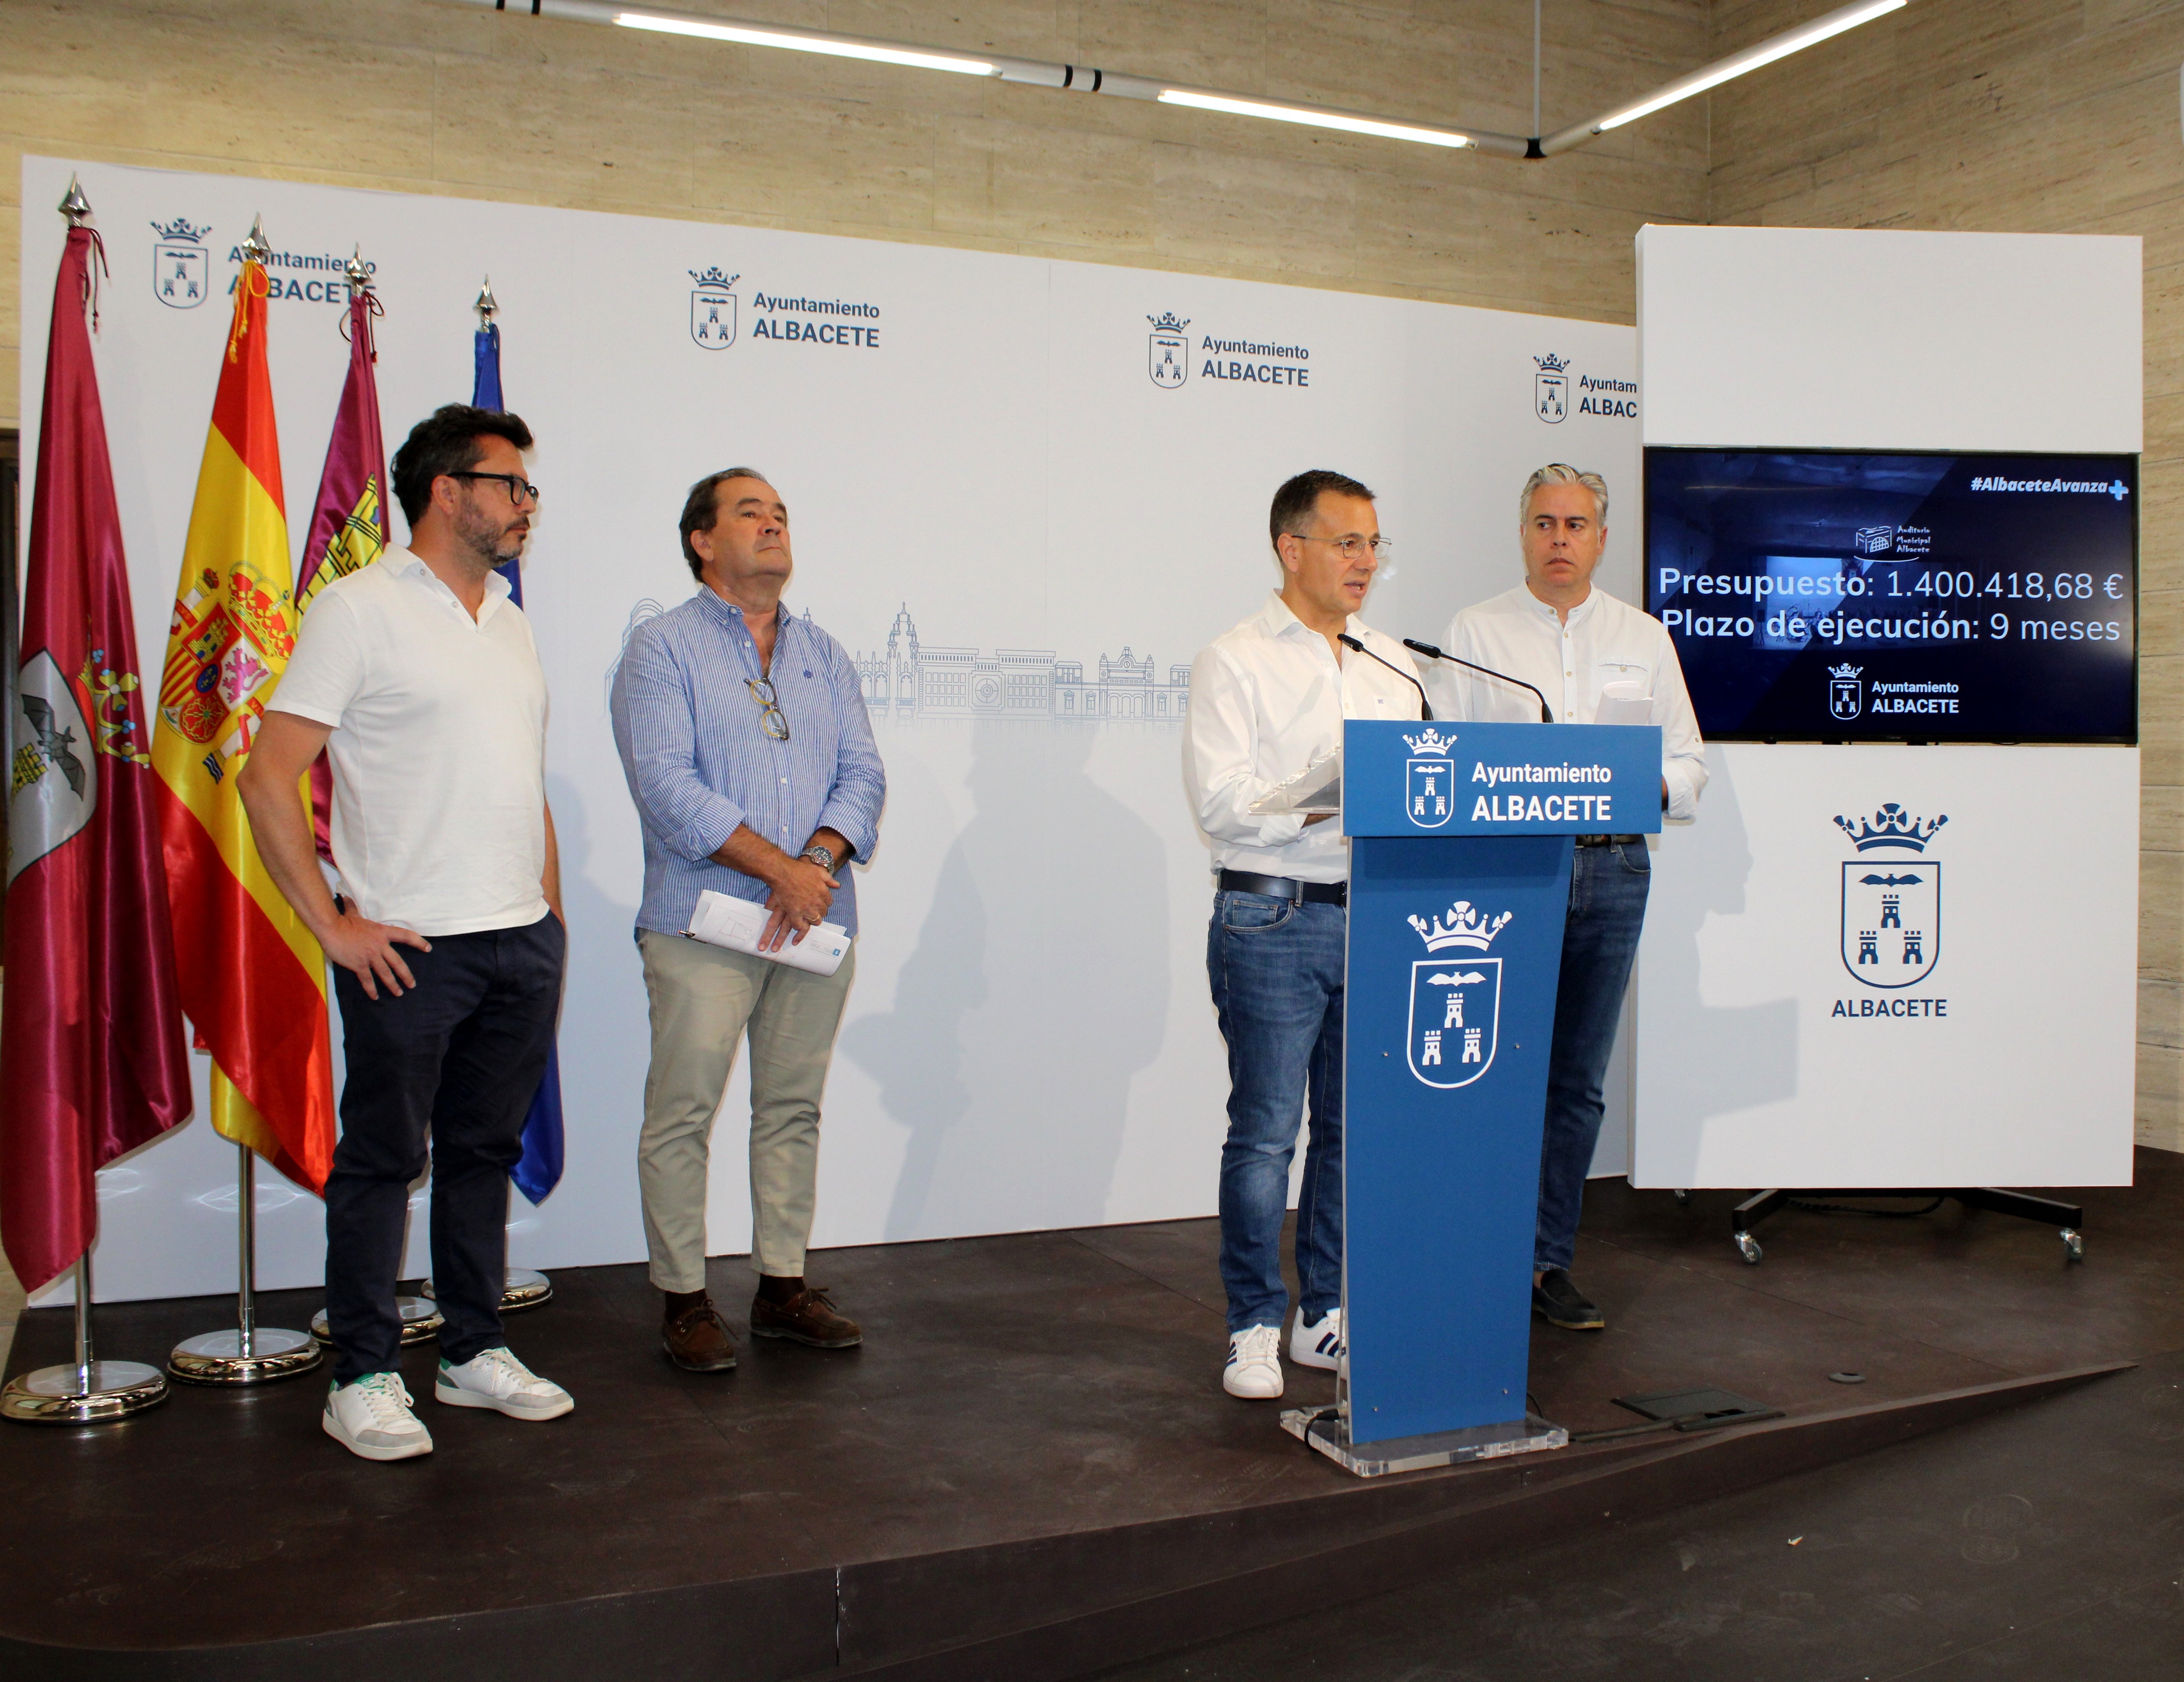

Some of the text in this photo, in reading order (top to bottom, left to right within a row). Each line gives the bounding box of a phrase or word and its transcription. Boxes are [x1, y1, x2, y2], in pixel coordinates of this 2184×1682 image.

[753, 292, 880, 318] Ayuntamiento
[753, 318, 880, 348] ALBACETE
[1201, 335, 1309, 360] Ayuntamiento
[1201, 360, 1309, 387] ALBACETE
[1896, 536, 1931, 545] Municipal
[1896, 545, 1930, 553] Albacete
[1660, 567, 2124, 602] Presupuesto: 1.400.418,68 €
[1662, 608, 2121, 645] Plazo de ejecución: 9 meses
[1872, 681, 1959, 695] Ayuntamiento
[1872, 698, 1959, 713] ALBACETE
[1471, 761, 1612, 788] Ayuntamiento
[1471, 795, 1612, 822] ALBACETE
[1831, 999, 1947, 1017] ALBACETE
